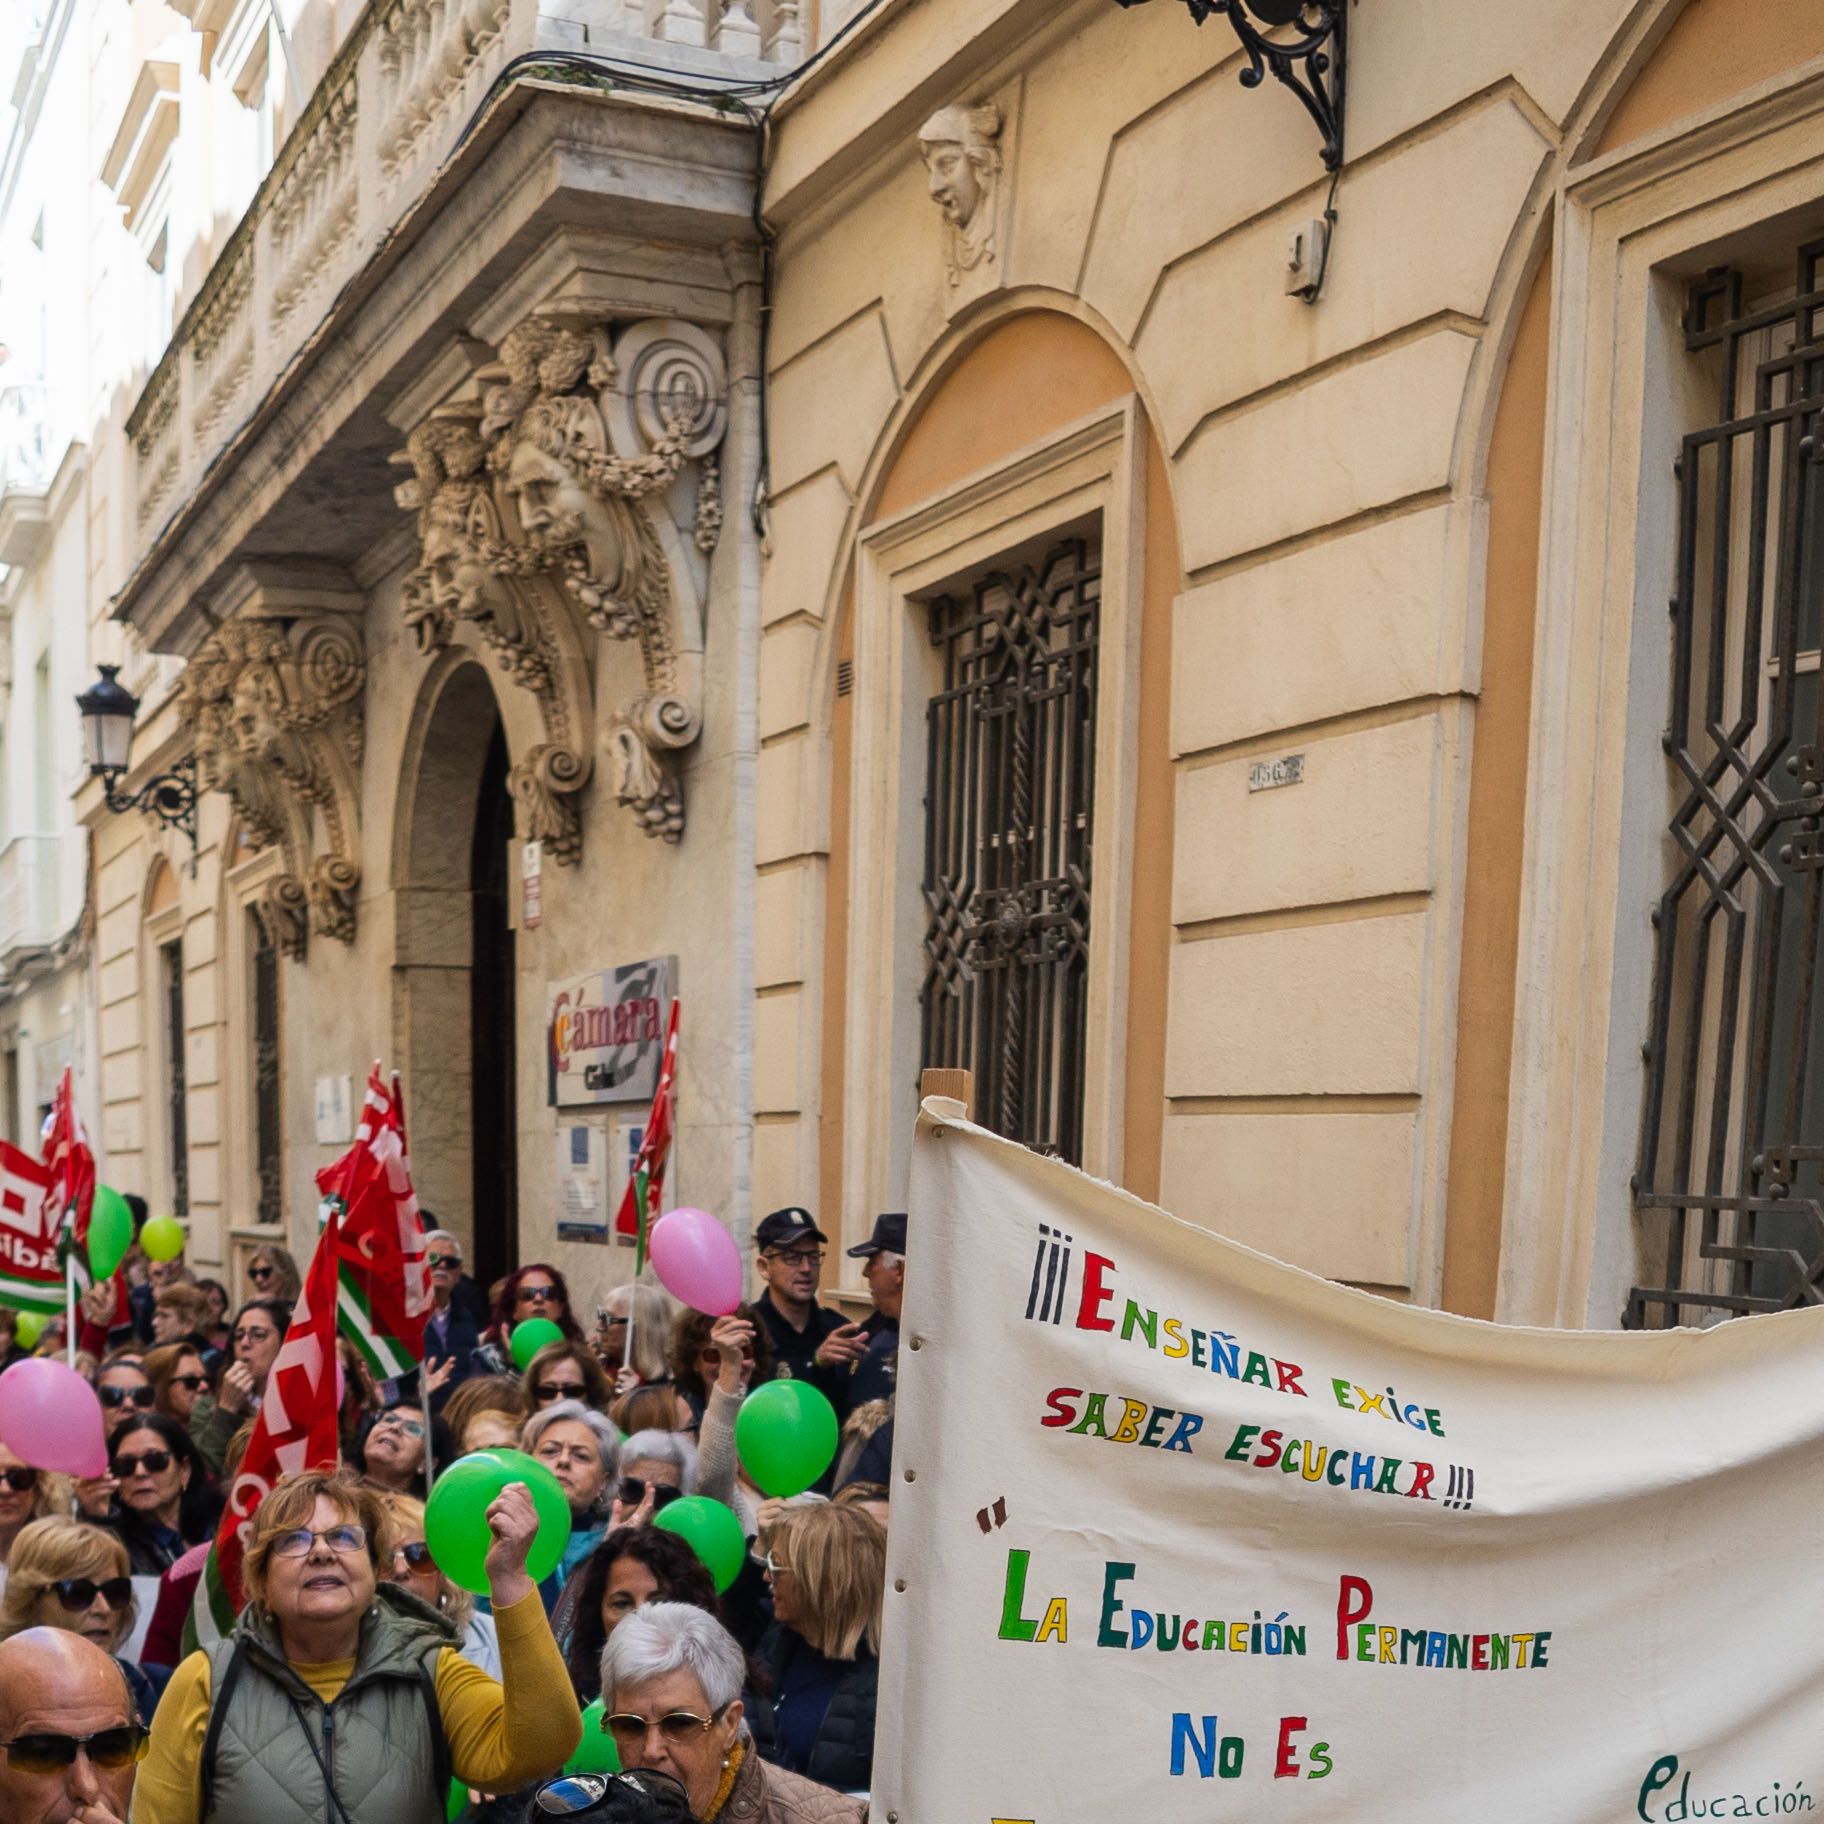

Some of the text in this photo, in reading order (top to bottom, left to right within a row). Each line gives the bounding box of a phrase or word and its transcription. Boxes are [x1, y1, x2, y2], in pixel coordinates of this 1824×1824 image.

[548, 986, 663, 1074] Cámara
[1040, 1386, 1204, 1455] SABER
[1097, 1561, 1308, 1656] EDUCACIÓN
[1336, 1574, 1553, 1671] PERMANENTE
